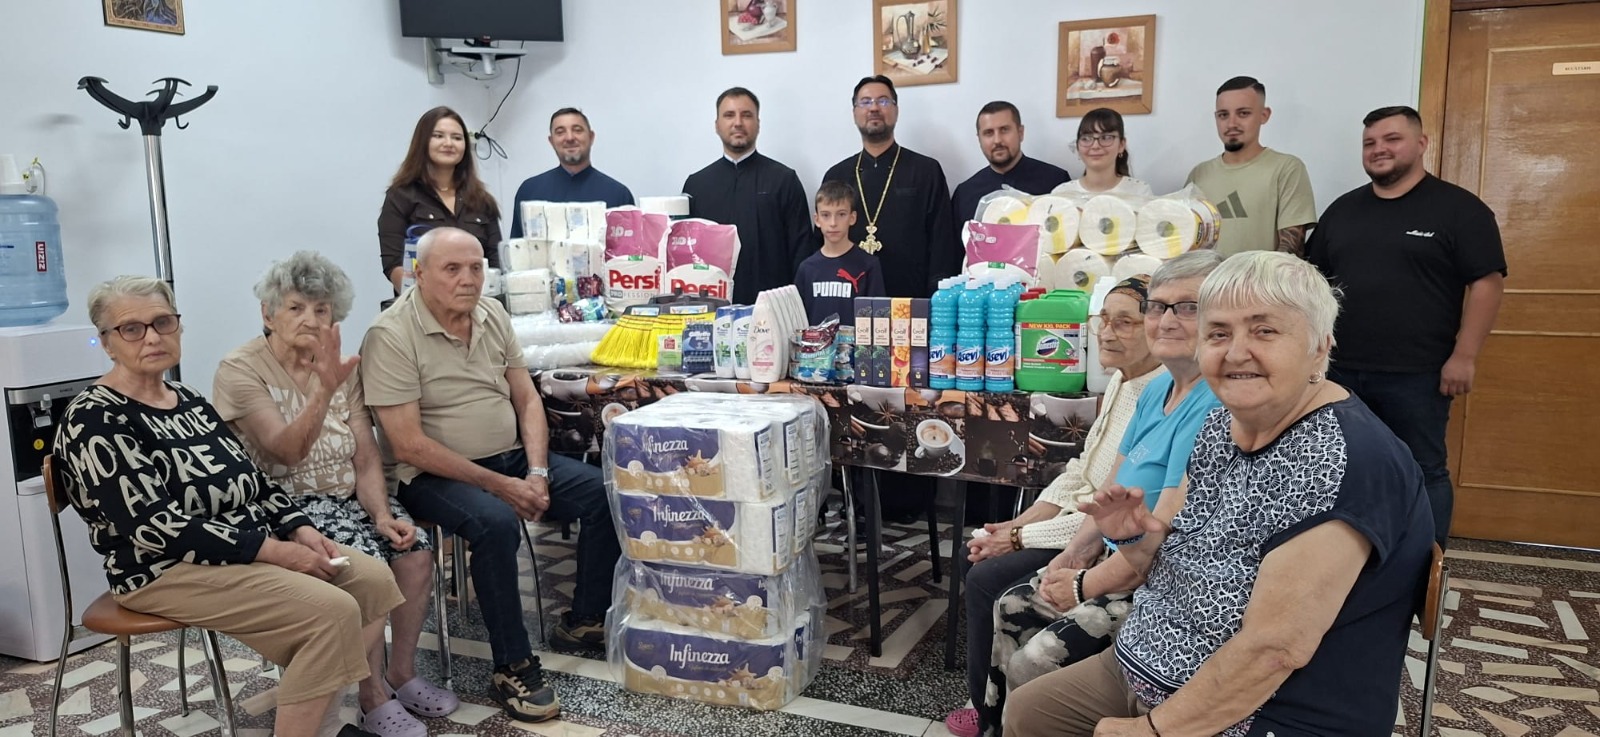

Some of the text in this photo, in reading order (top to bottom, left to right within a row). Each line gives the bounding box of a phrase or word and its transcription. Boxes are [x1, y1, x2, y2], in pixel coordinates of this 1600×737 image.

[609, 266, 661, 290] Persi
[812, 281, 852, 298] PUMA
[753, 325, 771, 334] Dove
[140, 405, 218, 440] AMORE
[660, 568, 715, 594] Infinezza
[669, 643, 731, 669] Infinezza
